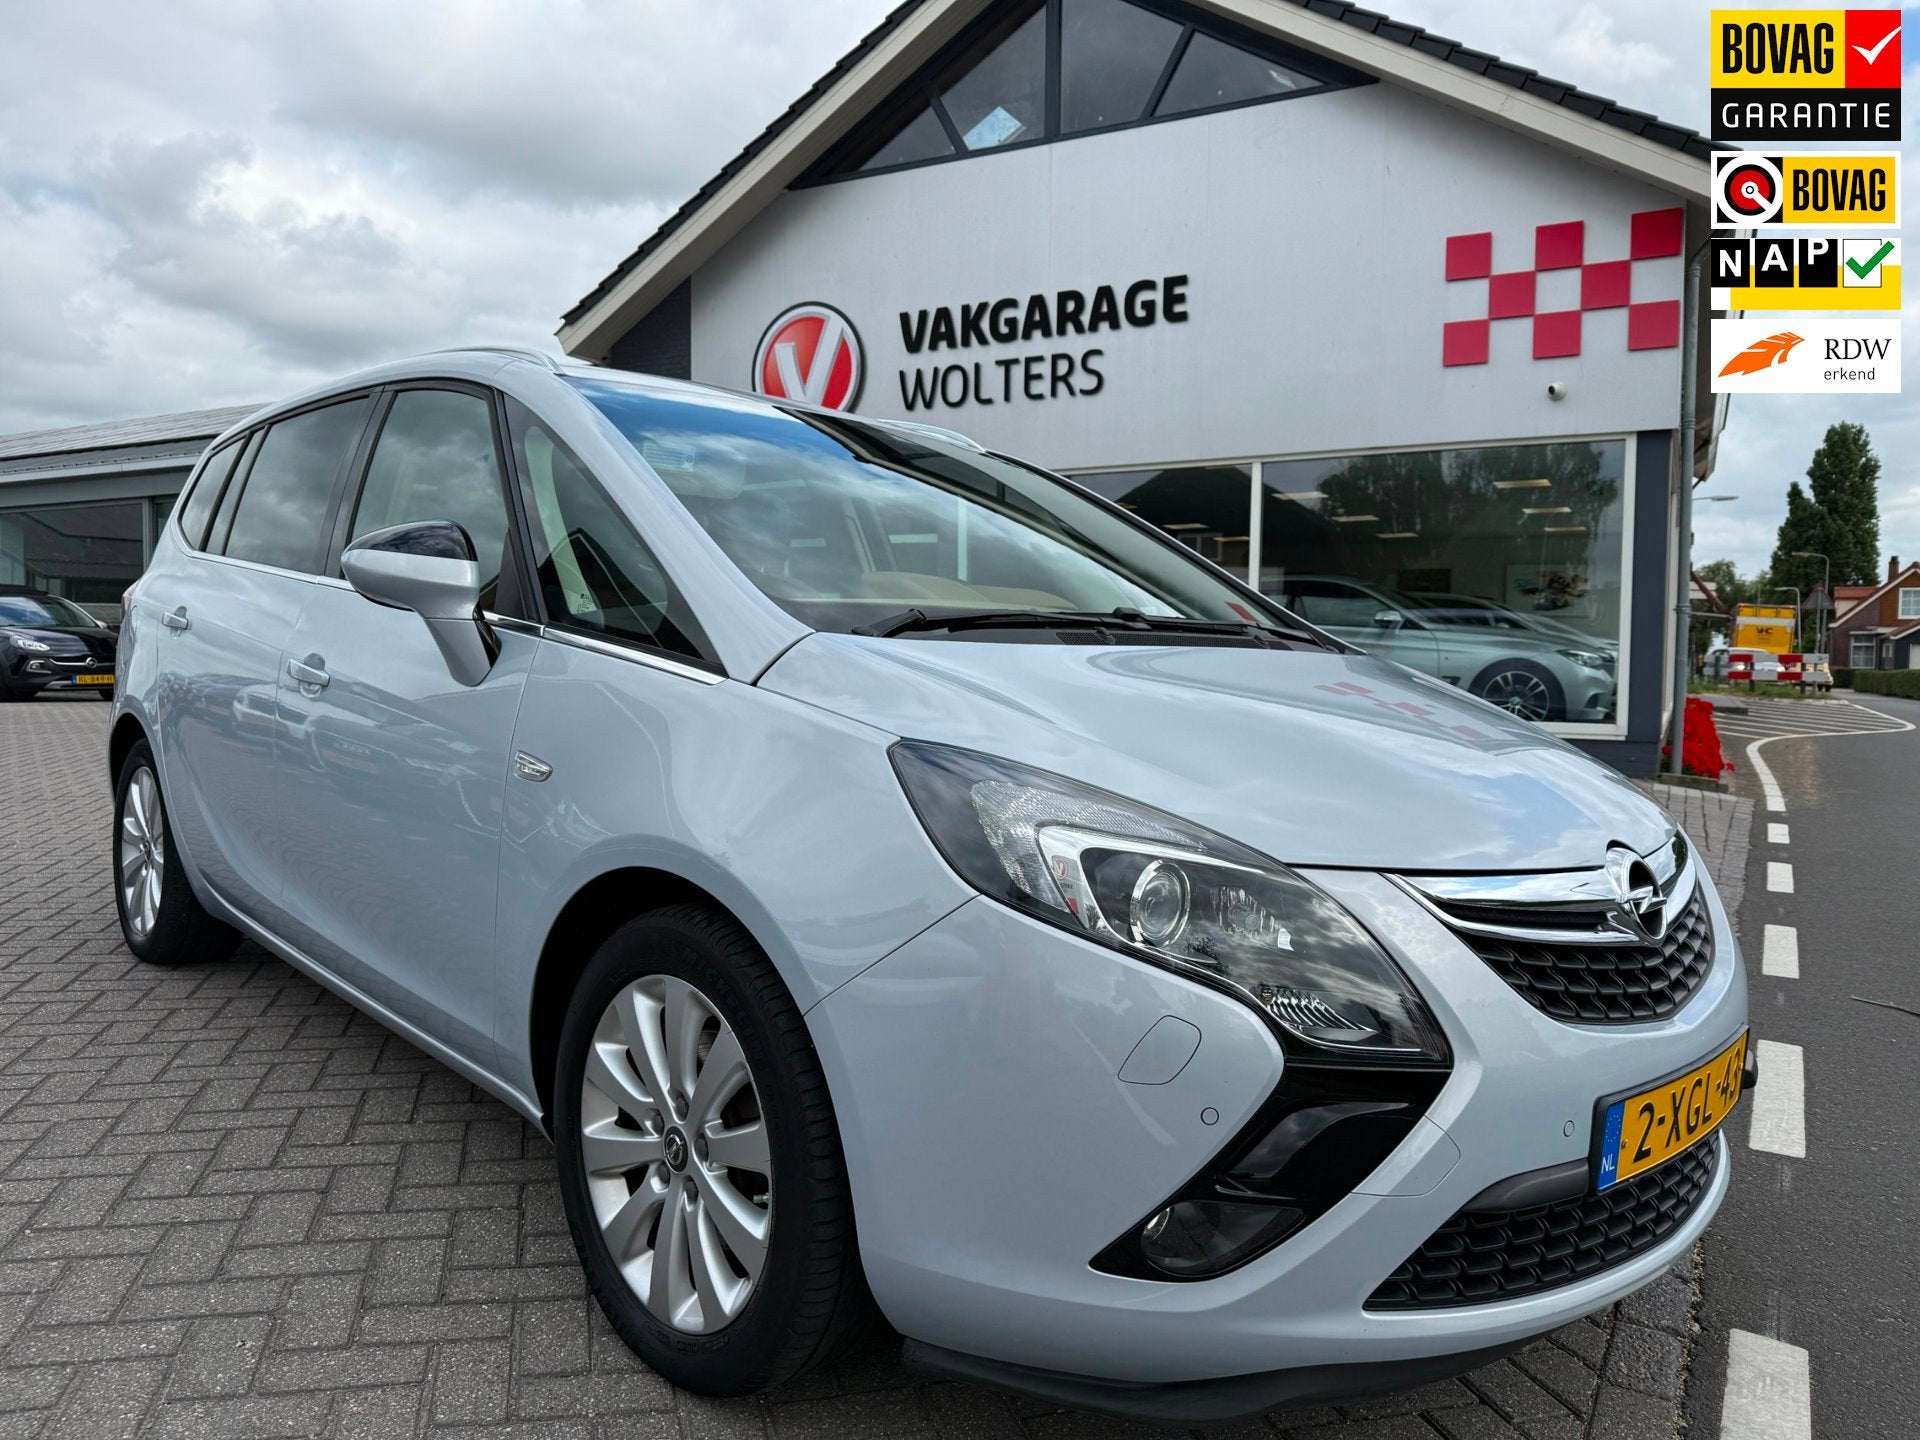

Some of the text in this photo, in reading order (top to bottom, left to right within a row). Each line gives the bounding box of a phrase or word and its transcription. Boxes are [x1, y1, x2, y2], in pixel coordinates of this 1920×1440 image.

[899, 274, 1189, 354] VAKGARAGE
[899, 349, 1105, 412] WOLTERS
[1633, 1047, 1741, 1163] 2-XGL-43
[1600, 1153, 1615, 1174] NL
